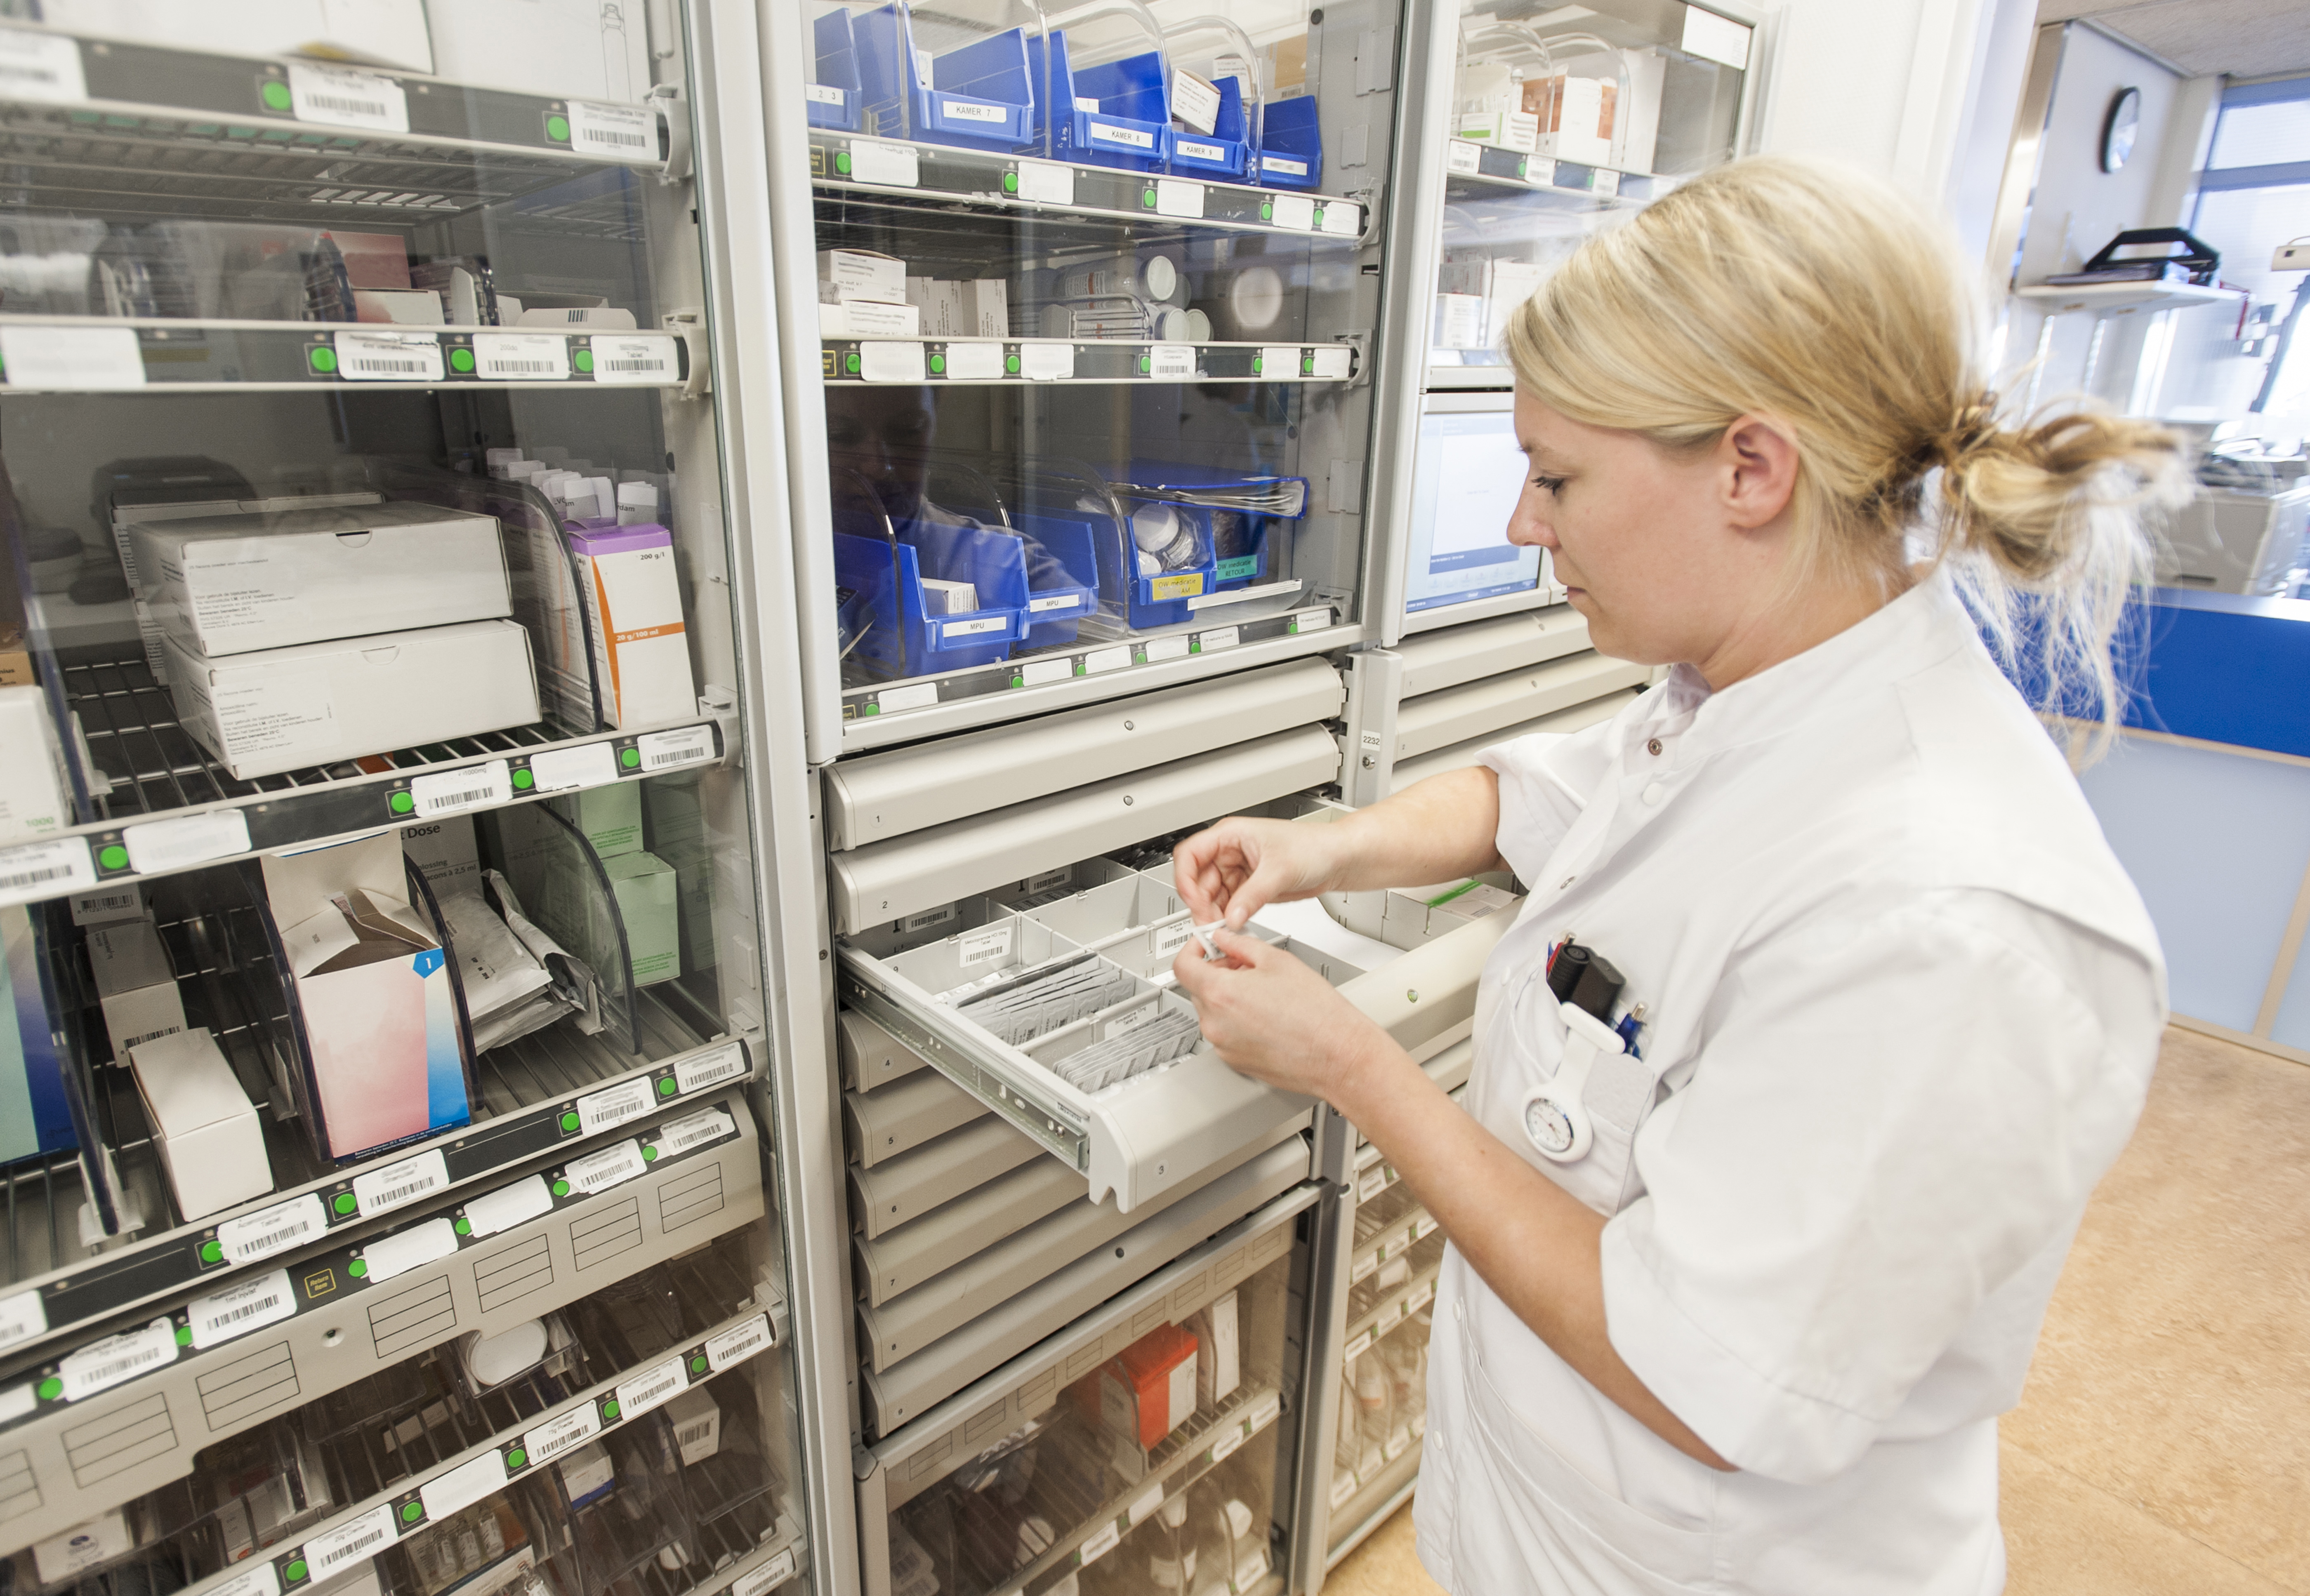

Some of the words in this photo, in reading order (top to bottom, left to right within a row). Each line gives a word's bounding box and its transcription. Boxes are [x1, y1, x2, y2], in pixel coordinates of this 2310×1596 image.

[957, 106, 981, 116] KAMER
[1112, 131, 1131, 140] KAMER
[1187, 146, 1205, 154] KAMER
[627, 632, 648, 640] g/100
[1363, 736, 1380, 745] 2232
[26, 817, 54, 827] 1000
[408, 825, 441, 839] Dose
[882, 901, 888, 909] 2
[426, 958, 431, 969] 1
[1159, 1165, 1164, 1175] 3
[309, 1276, 329, 1288] Return
